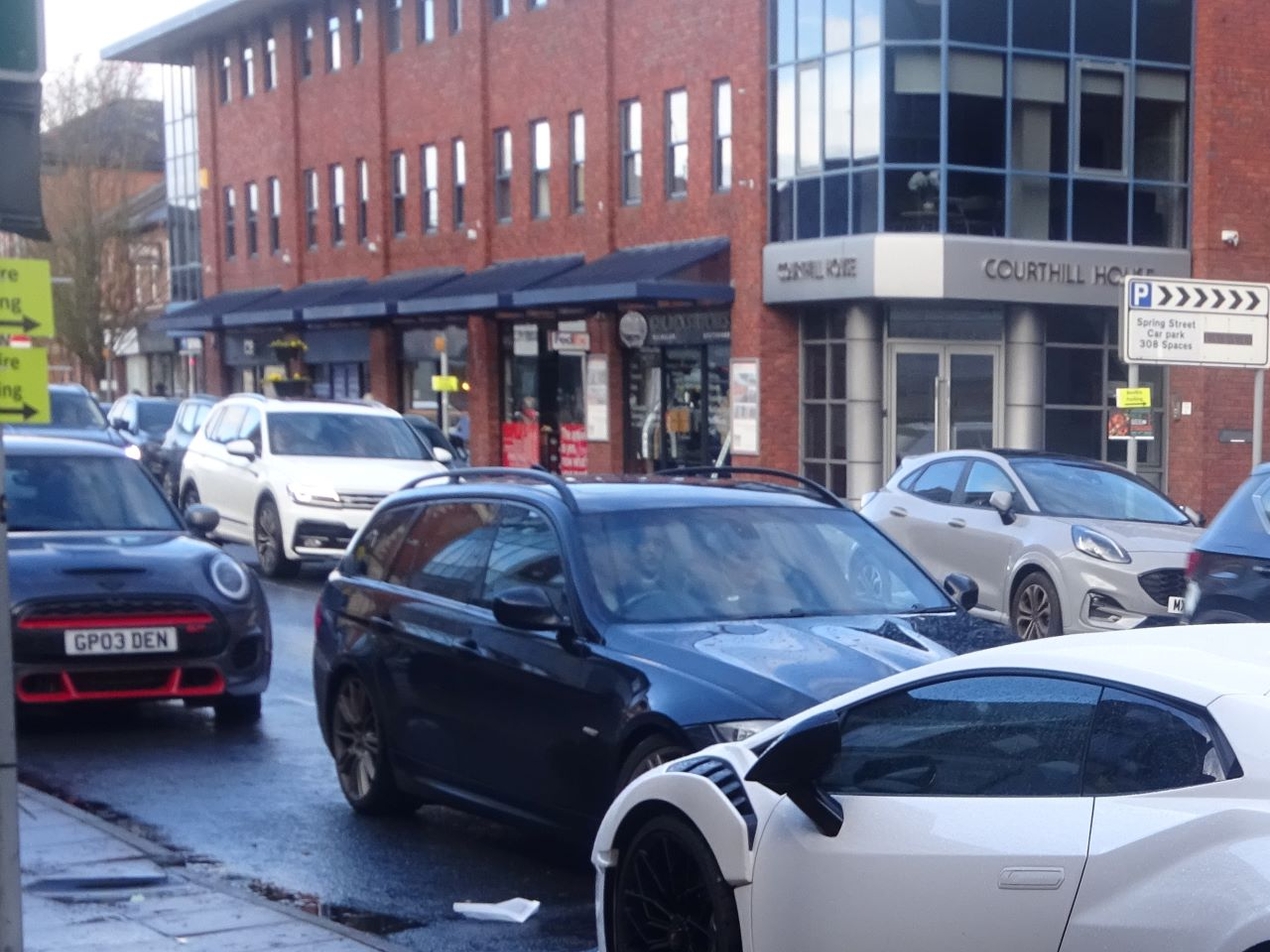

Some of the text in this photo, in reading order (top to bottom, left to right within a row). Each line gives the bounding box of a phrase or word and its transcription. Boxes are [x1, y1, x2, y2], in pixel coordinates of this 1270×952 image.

[984, 259, 1084, 284] COURTHILL
[1134, 283, 1149, 306] P
[1136, 317, 1196, 329] Spring Street
[1147, 328, 1185, 340] Car park
[1139, 339, 1193, 351] 308 Spaces
[131, 630, 168, 649] DEN
